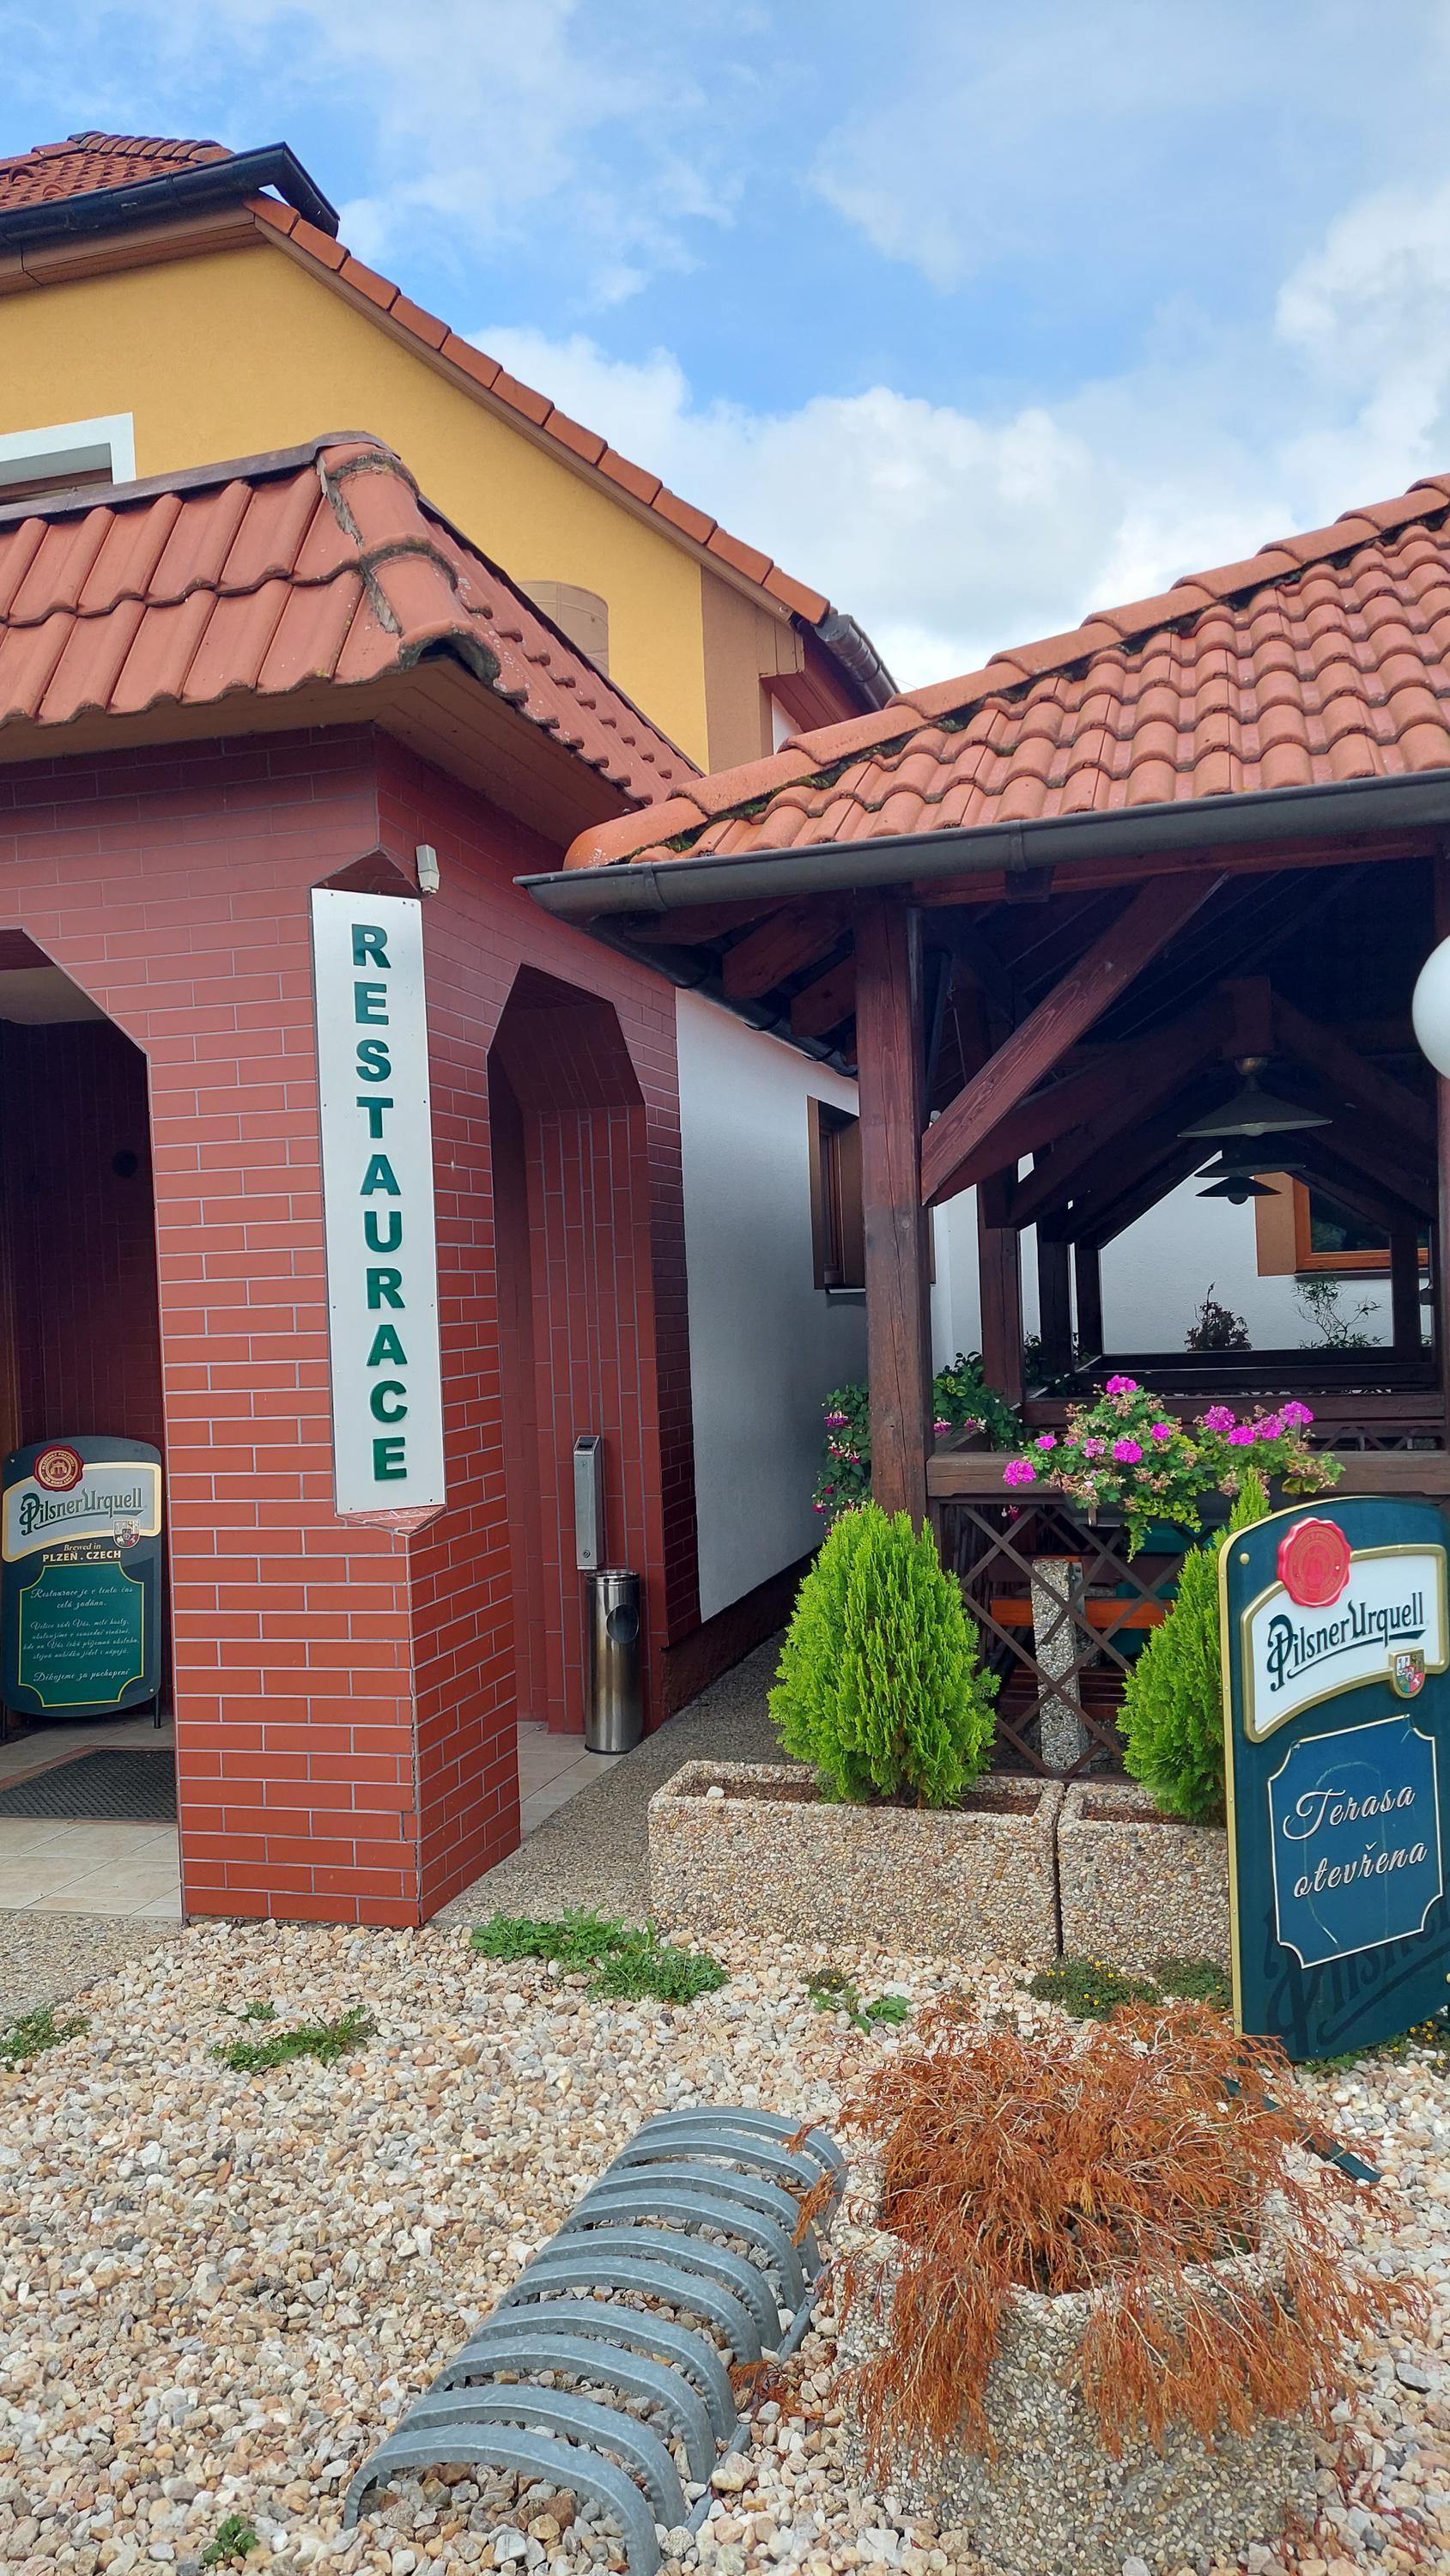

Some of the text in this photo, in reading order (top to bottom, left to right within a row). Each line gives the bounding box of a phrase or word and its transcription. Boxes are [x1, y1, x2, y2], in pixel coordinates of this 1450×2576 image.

[351, 923, 409, 1482] RESTAURACE
[19, 1487, 142, 1536] Pilsner Urquell
[64, 1543, 91, 1552] Brewed
[86, 1550, 122, 1560] CZECH
[30, 1589, 77, 1599] Restaurace
[99, 1586, 118, 1595] tento
[1266, 1591, 1424, 1692] Pilsner Urquell
[1283, 1785, 1417, 1840] Terasa
[1293, 1841, 1429, 1899] otevřena
